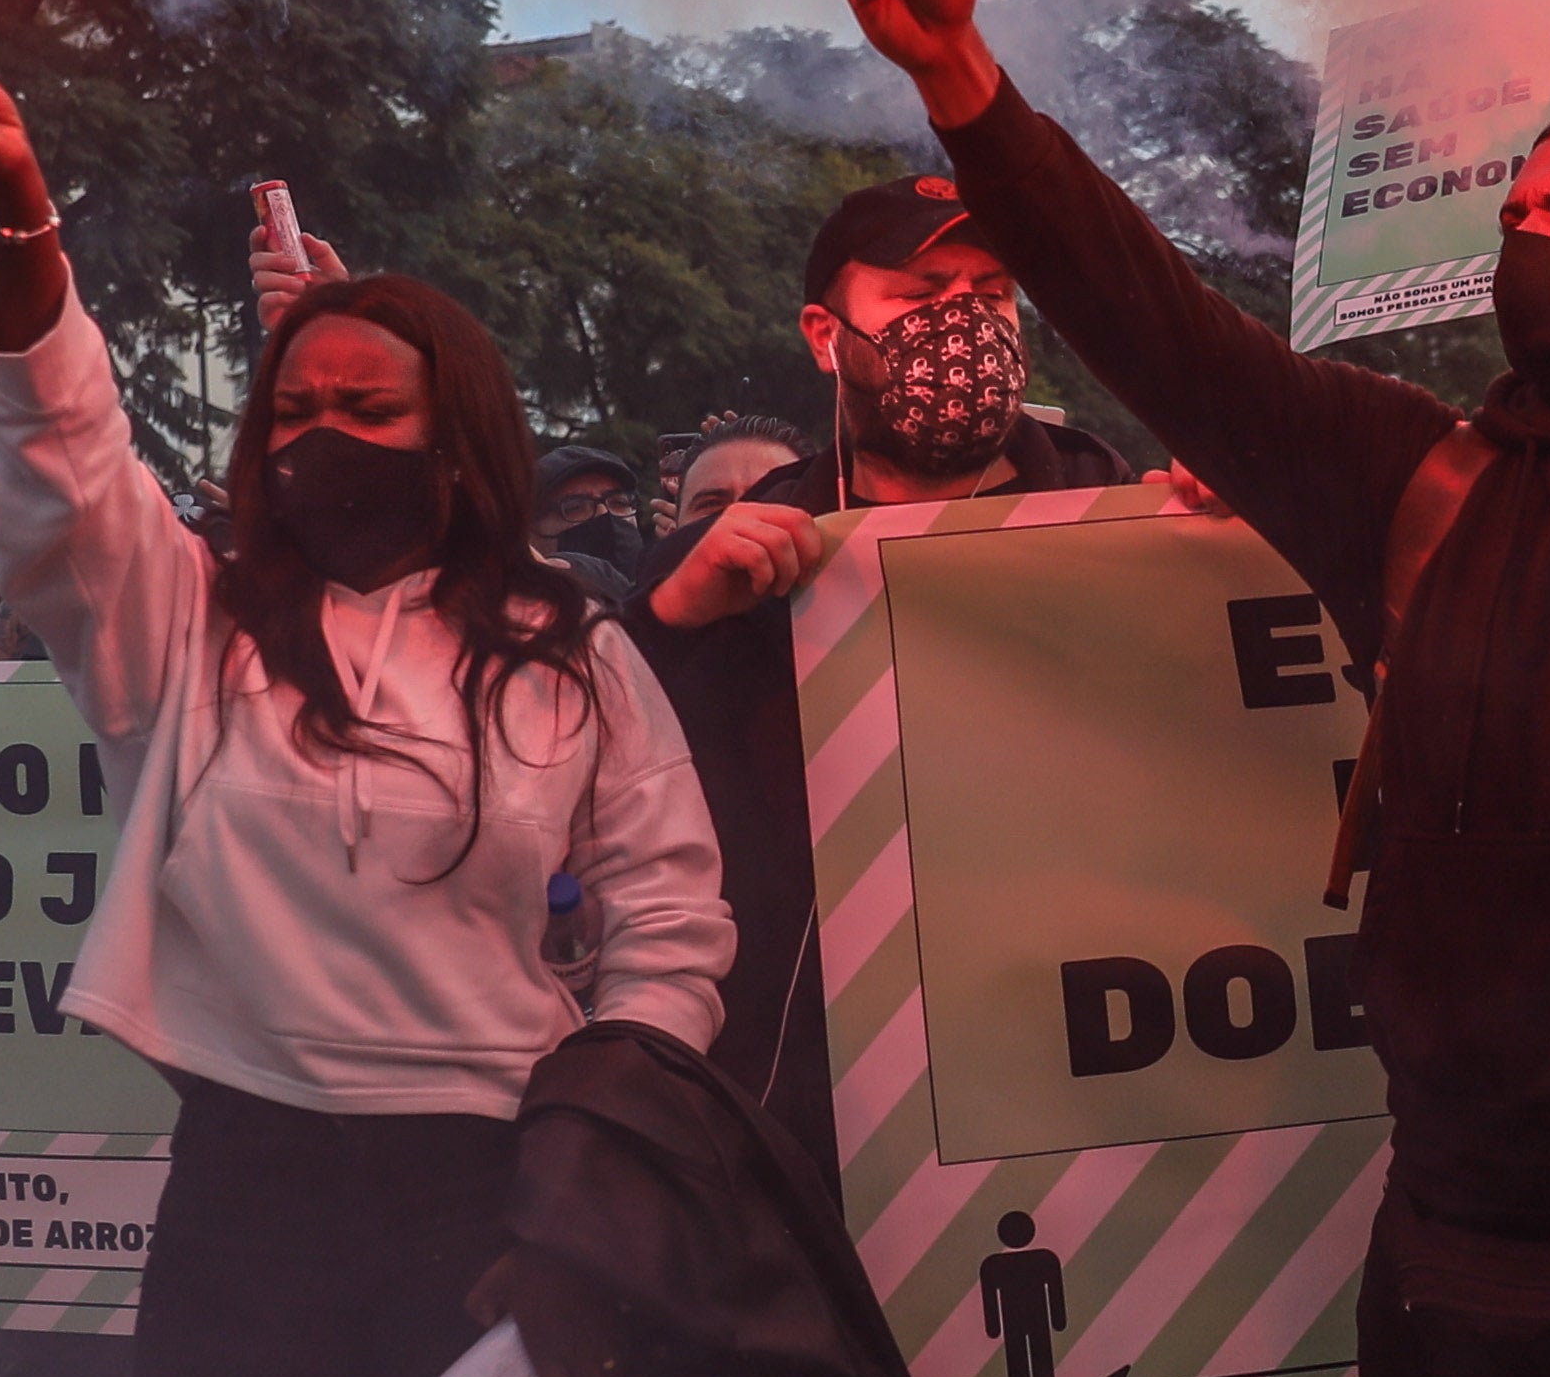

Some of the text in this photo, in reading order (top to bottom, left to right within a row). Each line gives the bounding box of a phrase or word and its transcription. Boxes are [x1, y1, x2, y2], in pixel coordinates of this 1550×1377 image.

[1346, 132, 1458, 178] SEM
[1339, 285, 1494, 321] SOMOS PESSOAS CANSA
[1373, 274, 1494, 305] NÃO SOMOS UM MO
